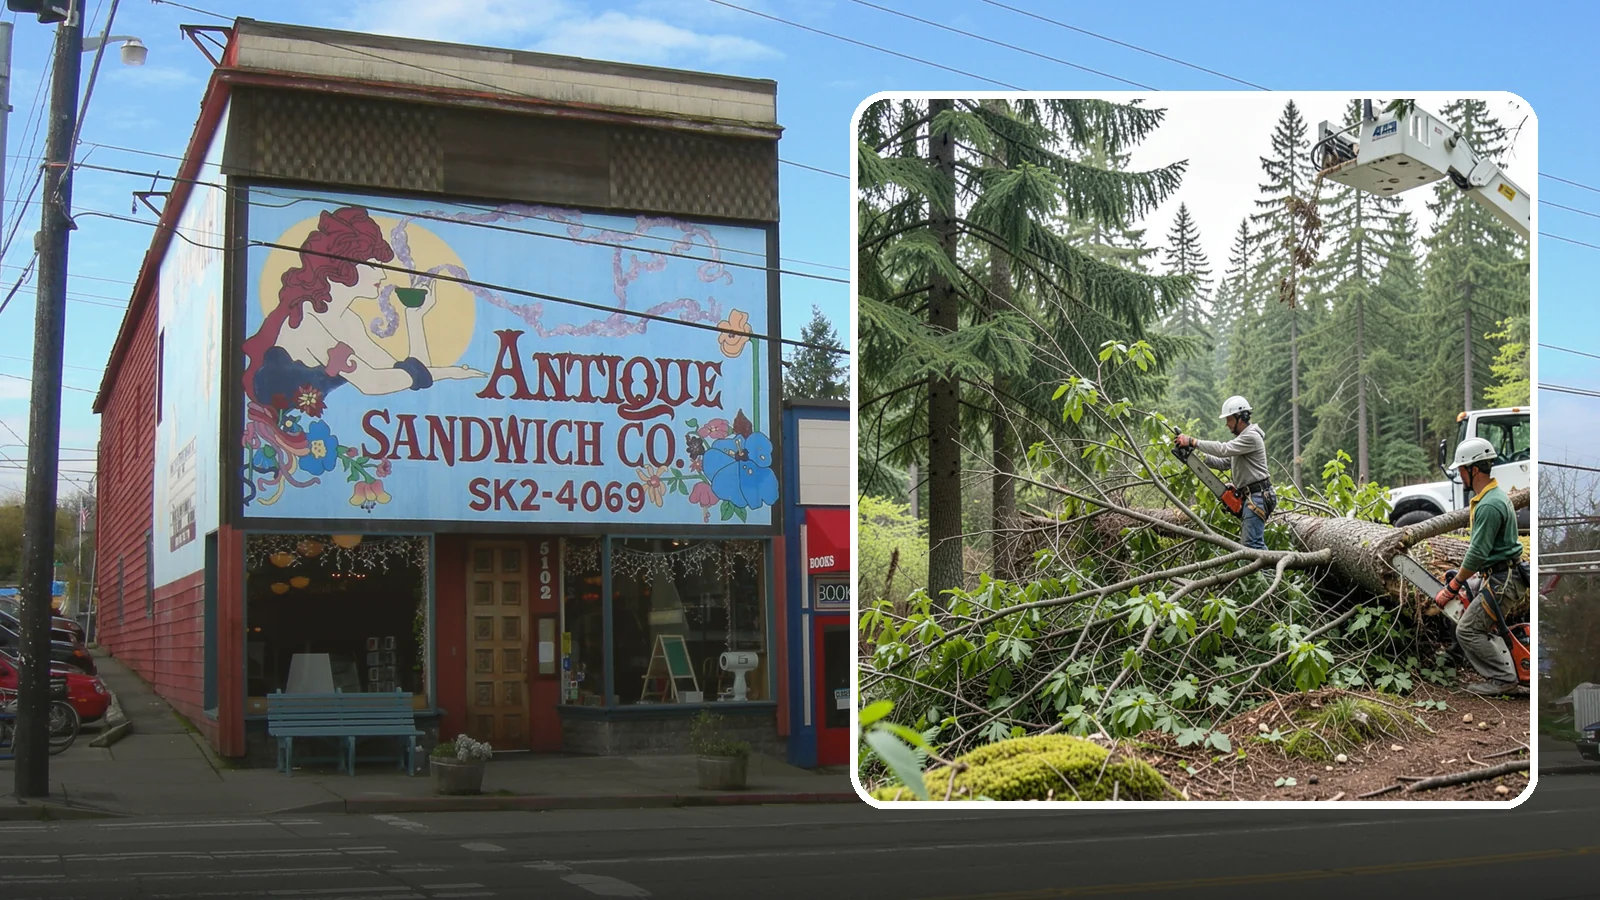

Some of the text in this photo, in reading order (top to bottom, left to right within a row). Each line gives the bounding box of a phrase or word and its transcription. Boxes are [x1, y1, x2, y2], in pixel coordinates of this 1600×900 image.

[475, 329, 723, 420] ANTIQUE
[361, 409, 685, 469] SANDWICH CO.
[468, 477, 645, 512] SK2-4069
[540, 542, 551, 599] 5102
[809, 555, 835, 569] BOOKS
